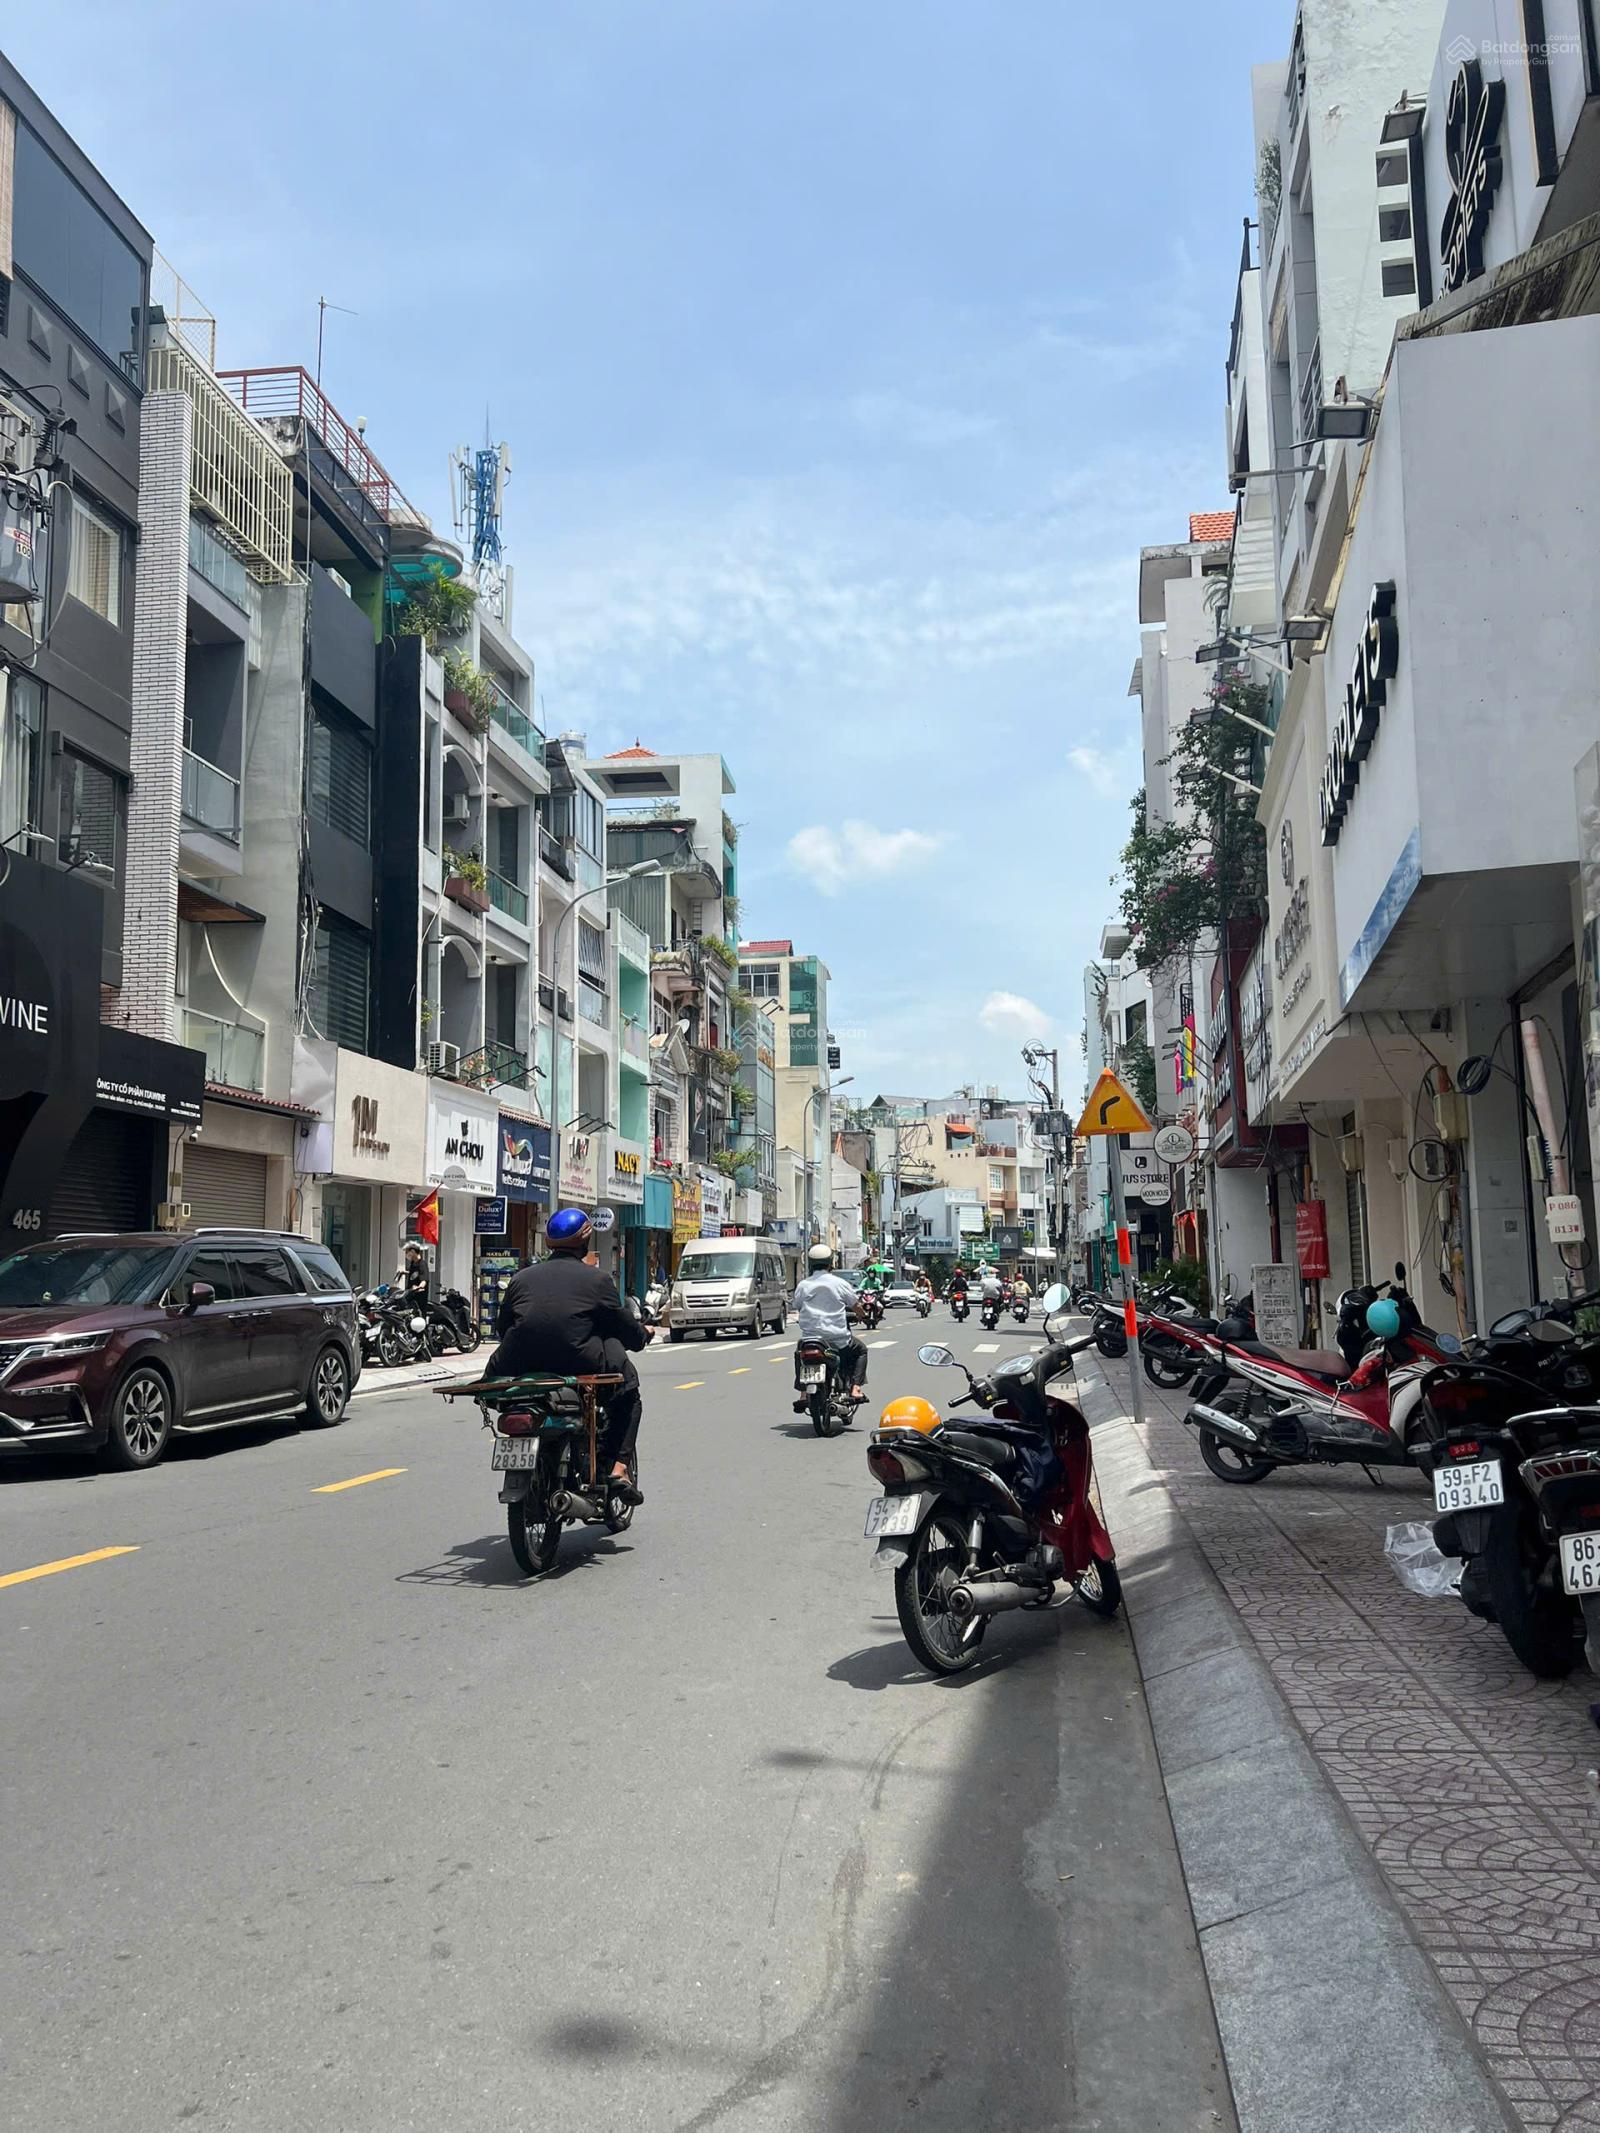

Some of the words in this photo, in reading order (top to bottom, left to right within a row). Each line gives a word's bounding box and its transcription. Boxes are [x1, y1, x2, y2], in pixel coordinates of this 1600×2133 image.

[445, 1137, 458, 1155] AN
[460, 1141, 483, 1161] CHOU
[1140, 1174, 1169, 1184] STORE
[478, 1205, 500, 1213] Dulux
[13, 1209, 41, 1230] 465
[495, 1454, 535, 1469] 283.58
[1442, 1463, 1492, 1489] 59-F2
[1438, 1482, 1501, 1510] 093.40
[871, 1516, 909, 1533] 7839
